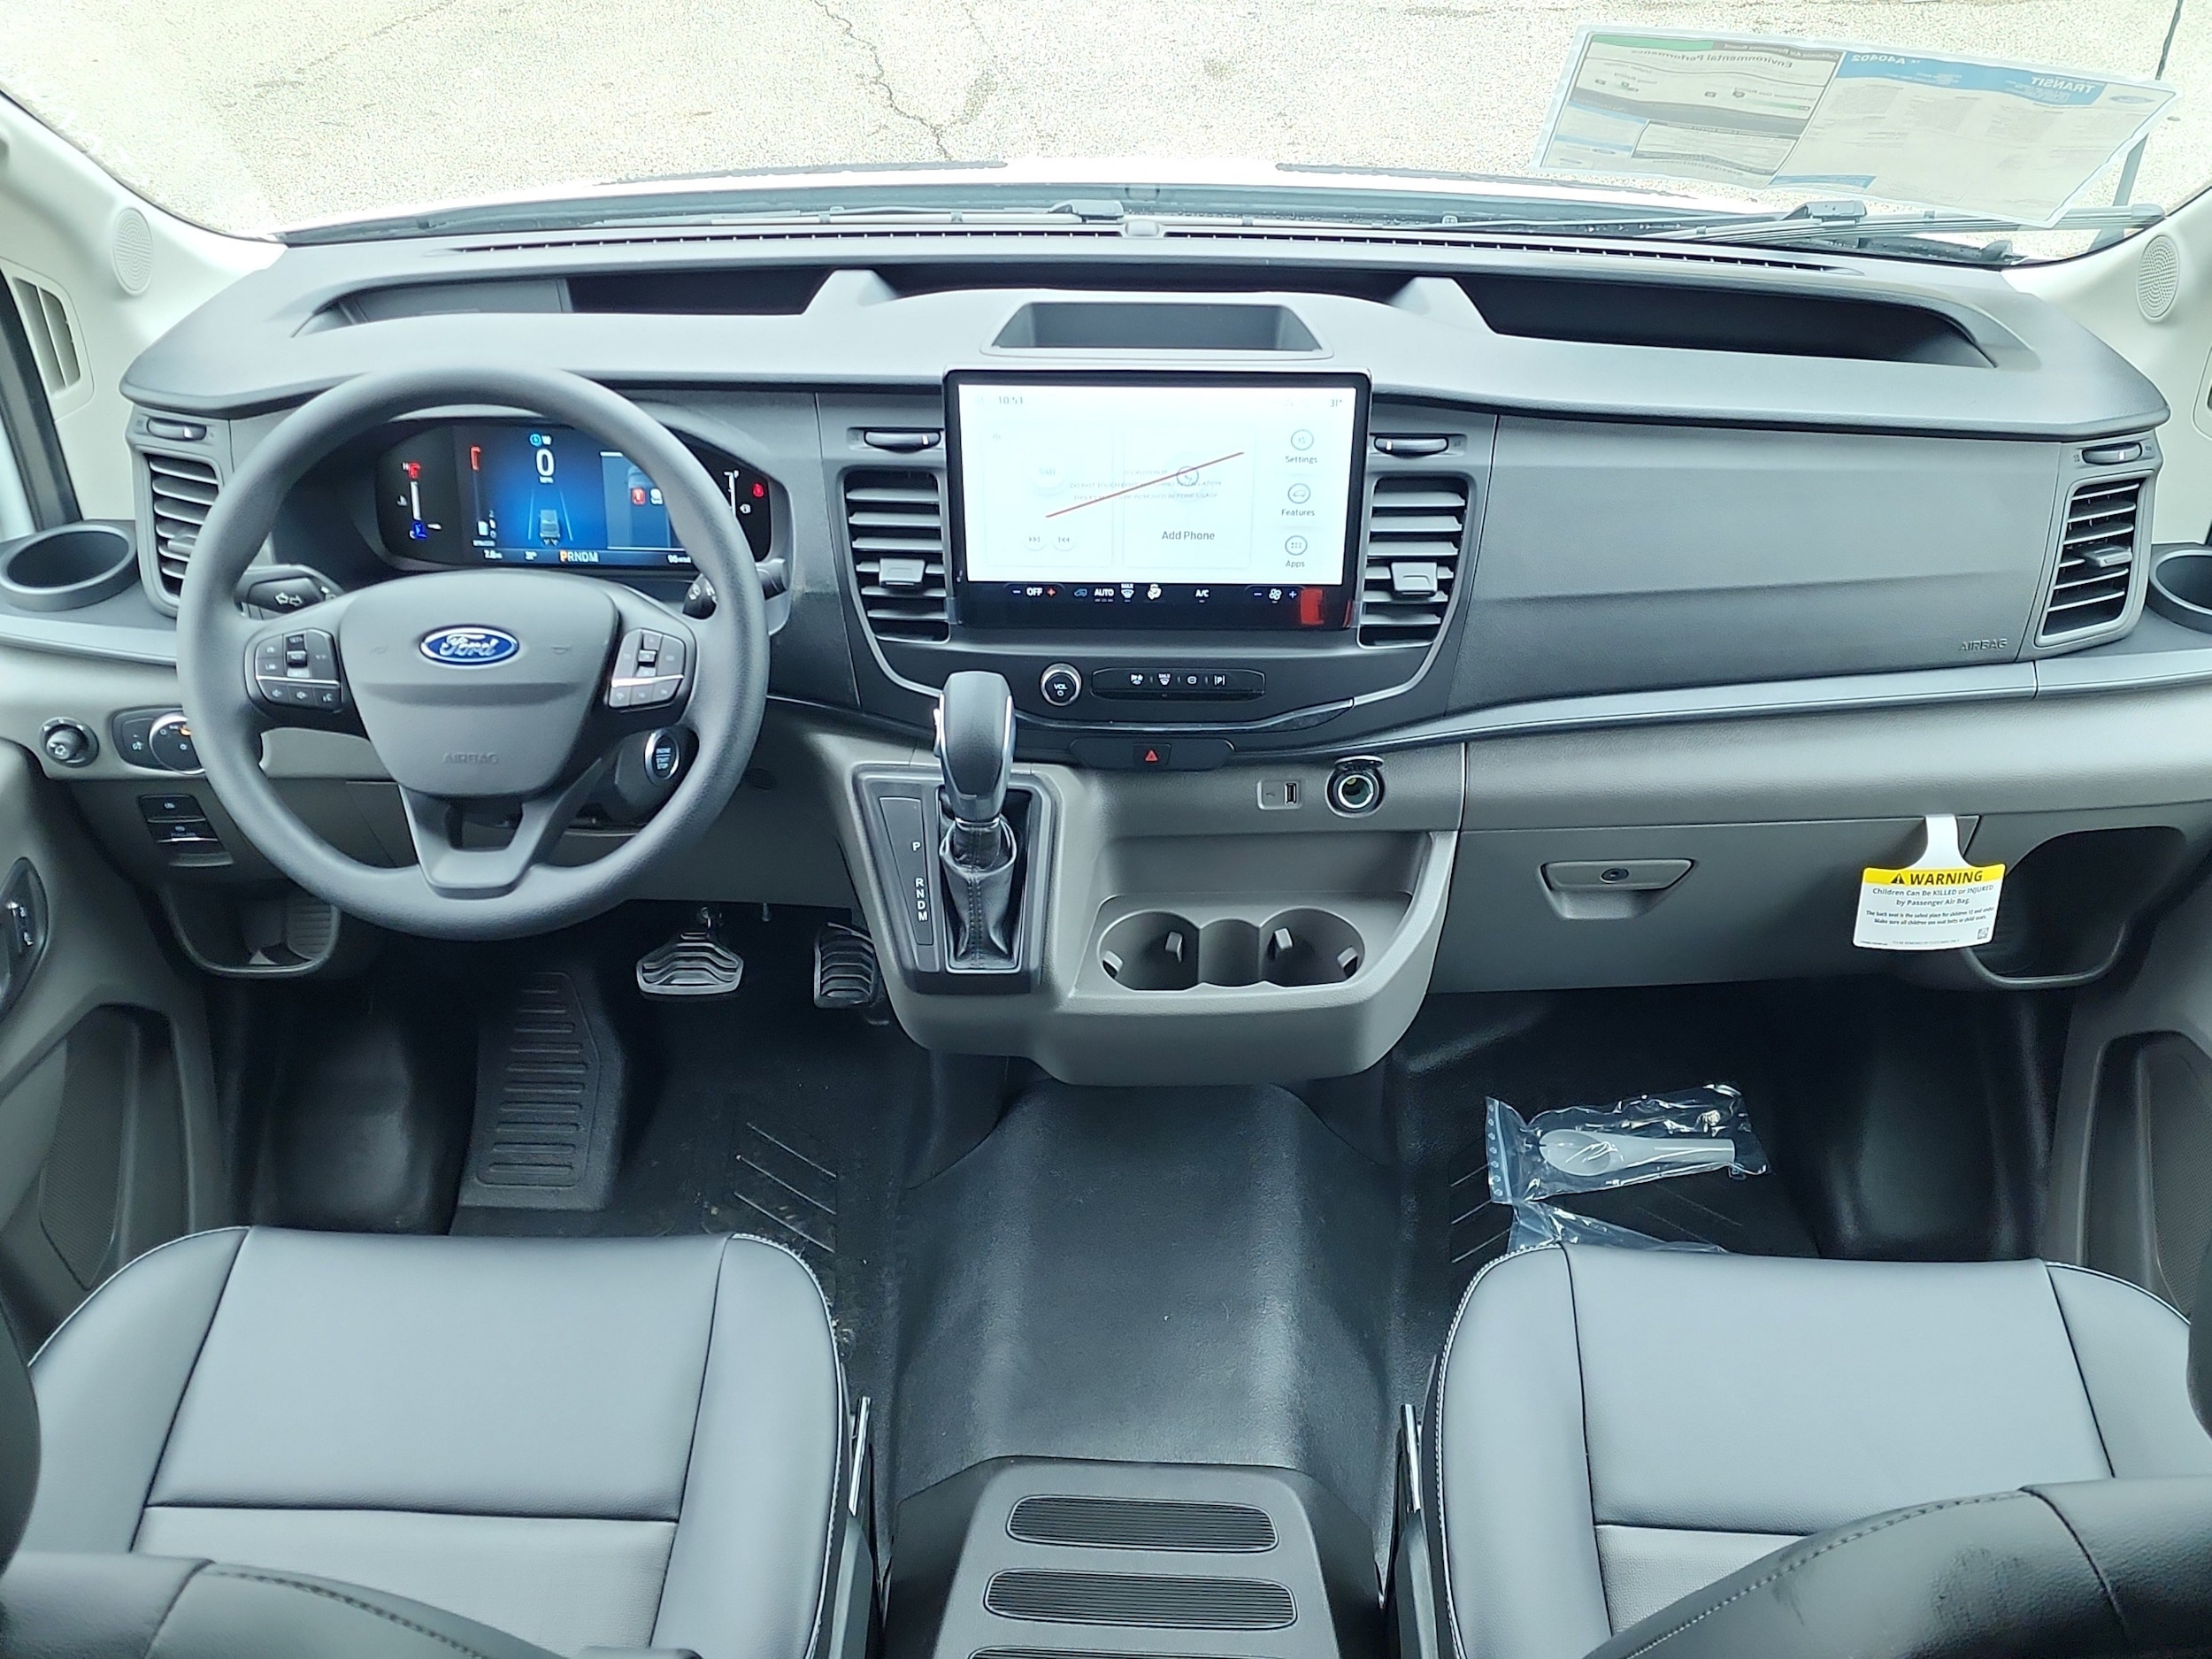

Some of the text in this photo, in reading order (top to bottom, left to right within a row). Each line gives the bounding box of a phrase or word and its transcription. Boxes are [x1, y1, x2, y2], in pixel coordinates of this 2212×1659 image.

[536, 449, 555, 476] 0
[1281, 508, 1316, 517] Features
[1162, 531, 1216, 541] Add Phone
[1026, 587, 1043, 596] OFF
[1094, 588, 1115, 597] AUTO
[1195, 588, 1210, 598] A/C
[440, 634, 500, 657] Ford
[1959, 638, 2008, 652] AIRBAG
[442, 752, 499, 764] AIRBAG
[912, 841, 921, 851] P
[916, 877, 925, 887] R
[1909, 871, 1983, 886] WARNING
[917, 889, 926, 898] N
[1872, 887, 1905, 896] Children
[1967, 885, 1993, 895] INJURED
[918, 901, 926, 910] D
[918, 911, 928, 921] M
